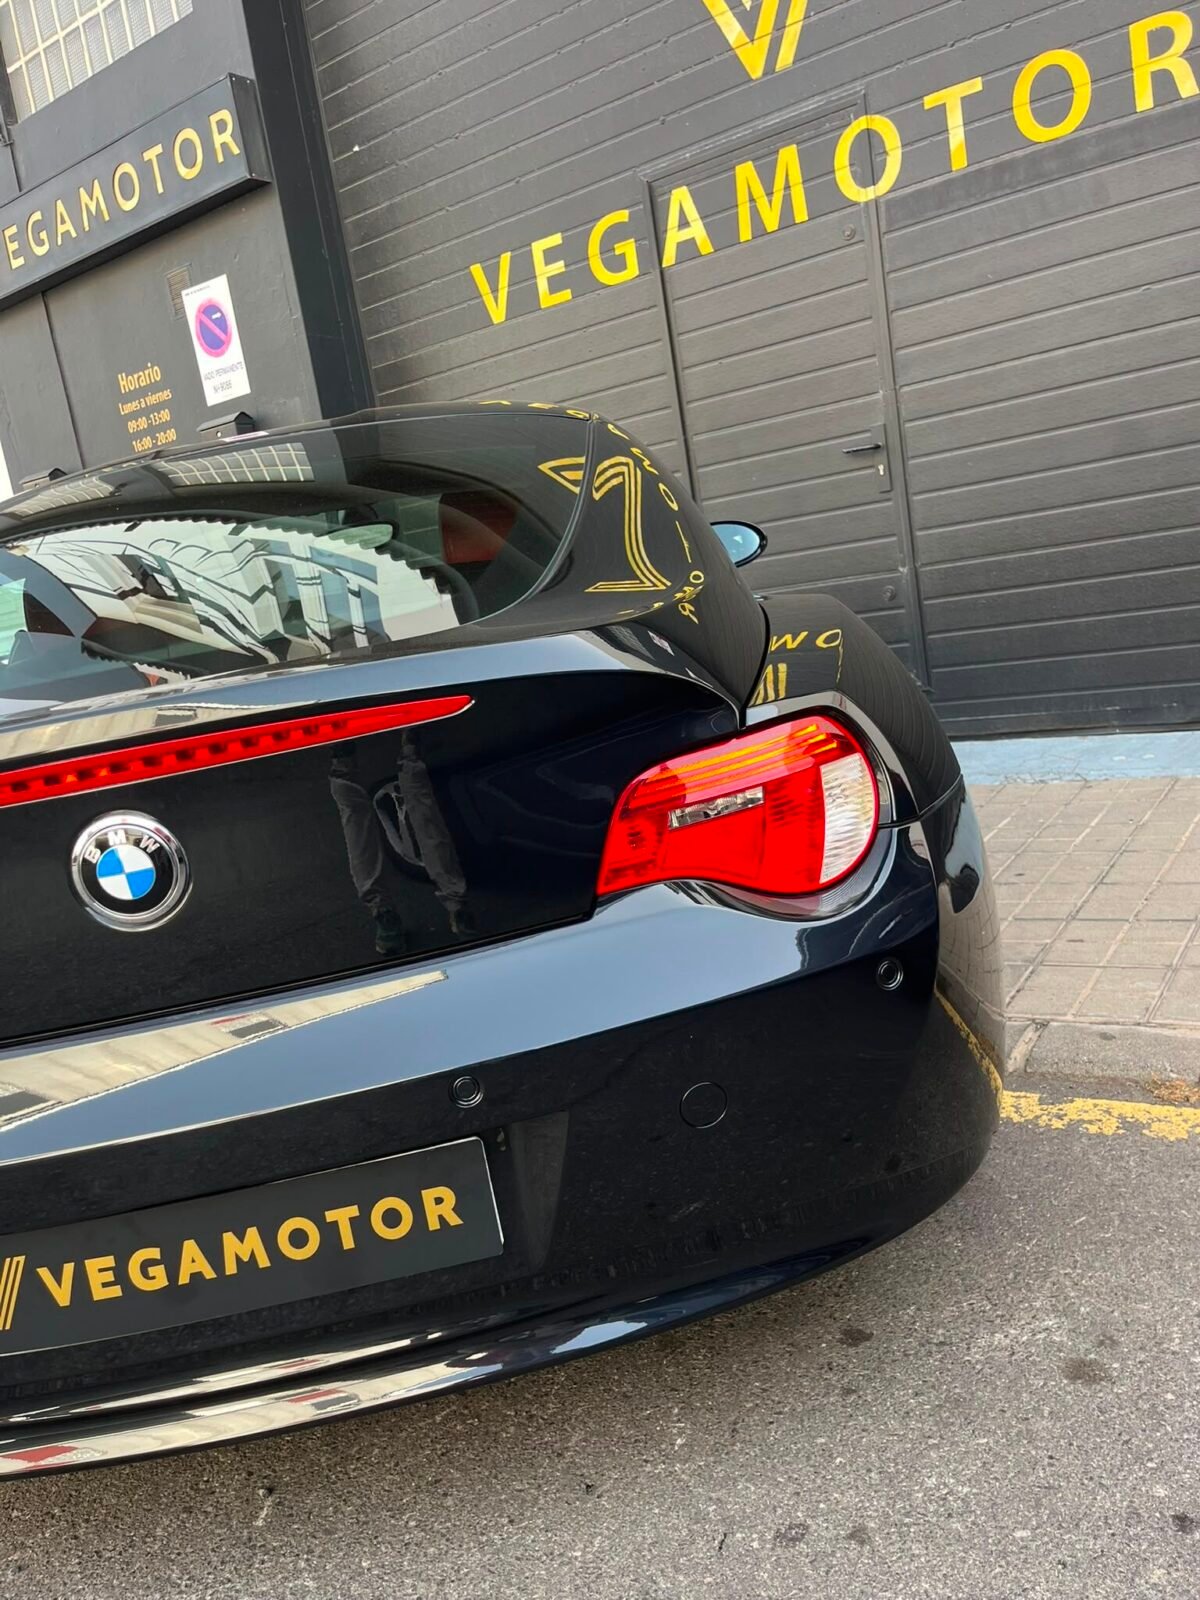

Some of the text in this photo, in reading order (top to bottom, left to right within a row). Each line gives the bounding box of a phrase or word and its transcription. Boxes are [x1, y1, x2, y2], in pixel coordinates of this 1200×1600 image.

[469, 10, 1200, 323] VEGAMOTOR
[118, 362, 161, 393] Horario
[118, 389, 172, 415] Lunes a viernes
[127, 416, 148, 433] 09:00
[132, 436, 152, 452] 16:00
[156, 428, 176, 446] 20:00
[84, 829, 160, 864] BMW
[36, 1186, 464, 1307] VEGAMOTOR
